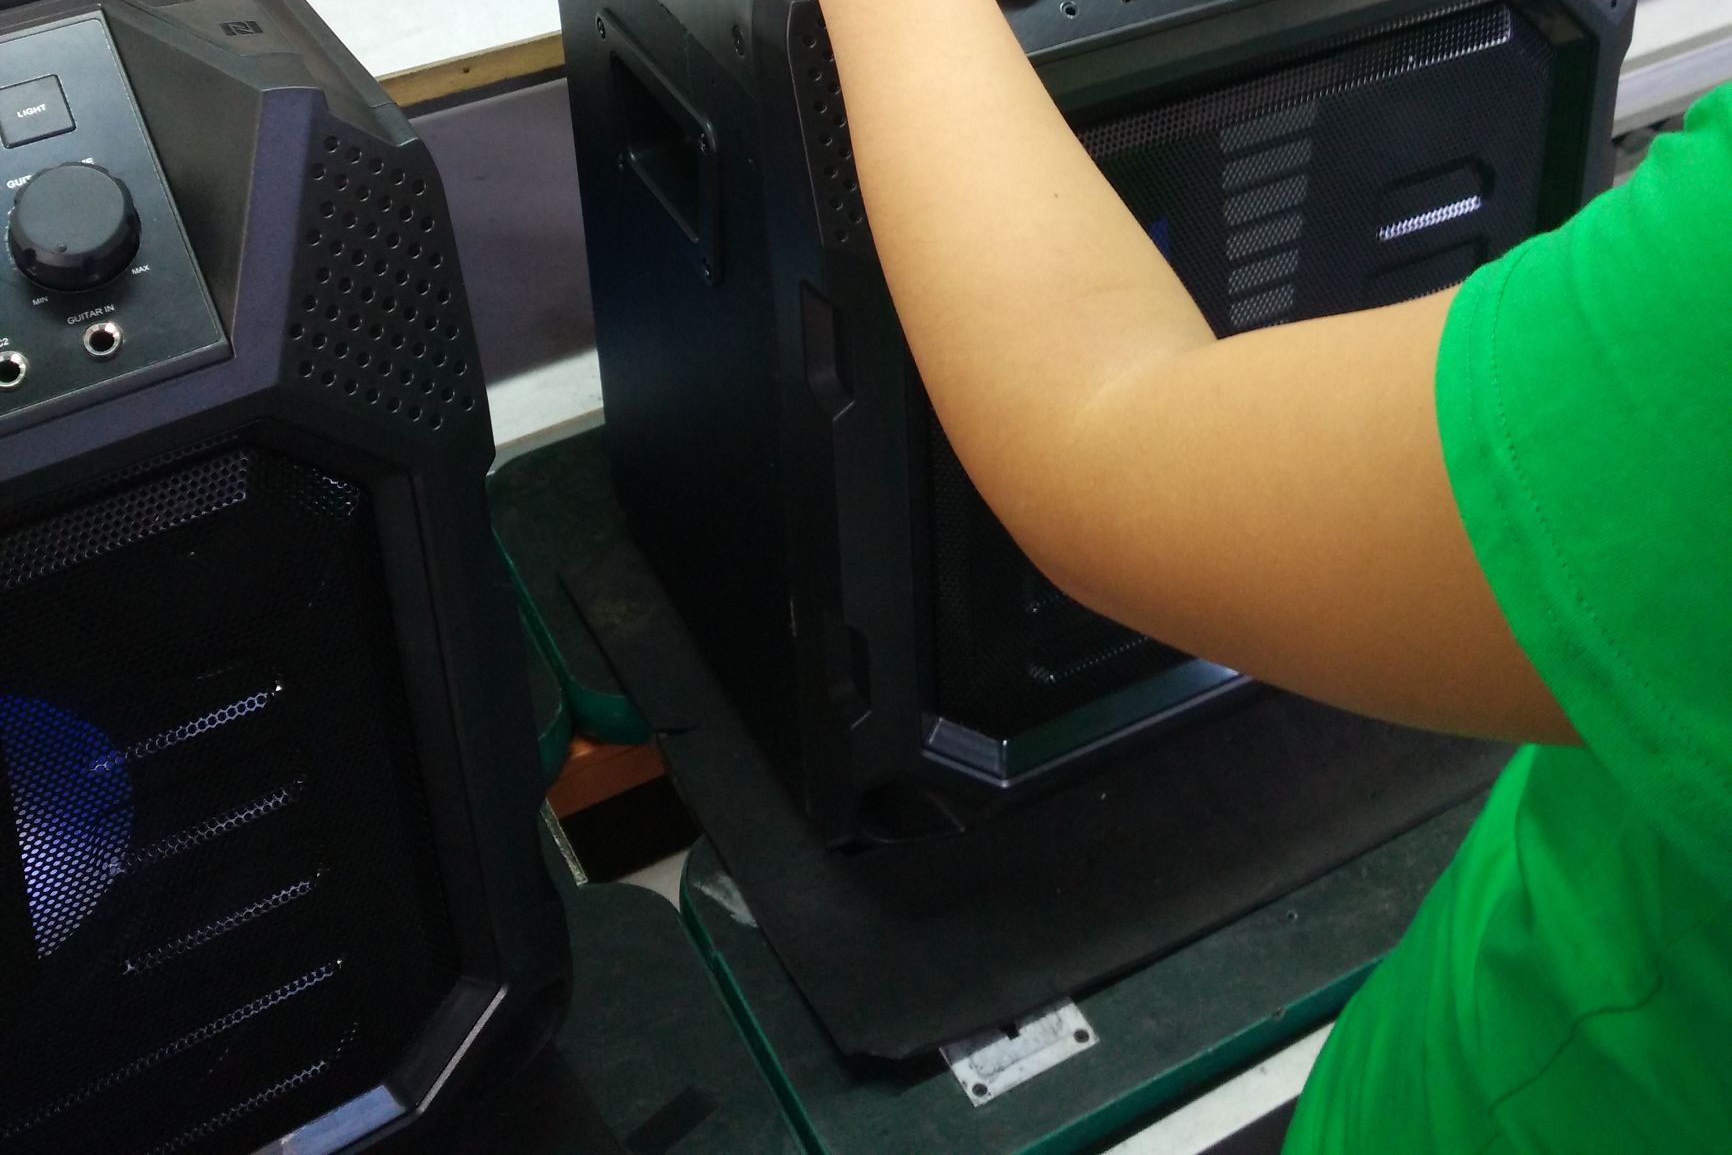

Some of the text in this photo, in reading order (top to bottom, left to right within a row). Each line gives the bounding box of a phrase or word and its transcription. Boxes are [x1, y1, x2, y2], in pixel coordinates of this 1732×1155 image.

[17, 104, 46, 117] LIGHT
[132, 265, 150, 274] MAX
[32, 296, 48, 305] MIN
[67, 304, 115, 325] GUITAR IN
